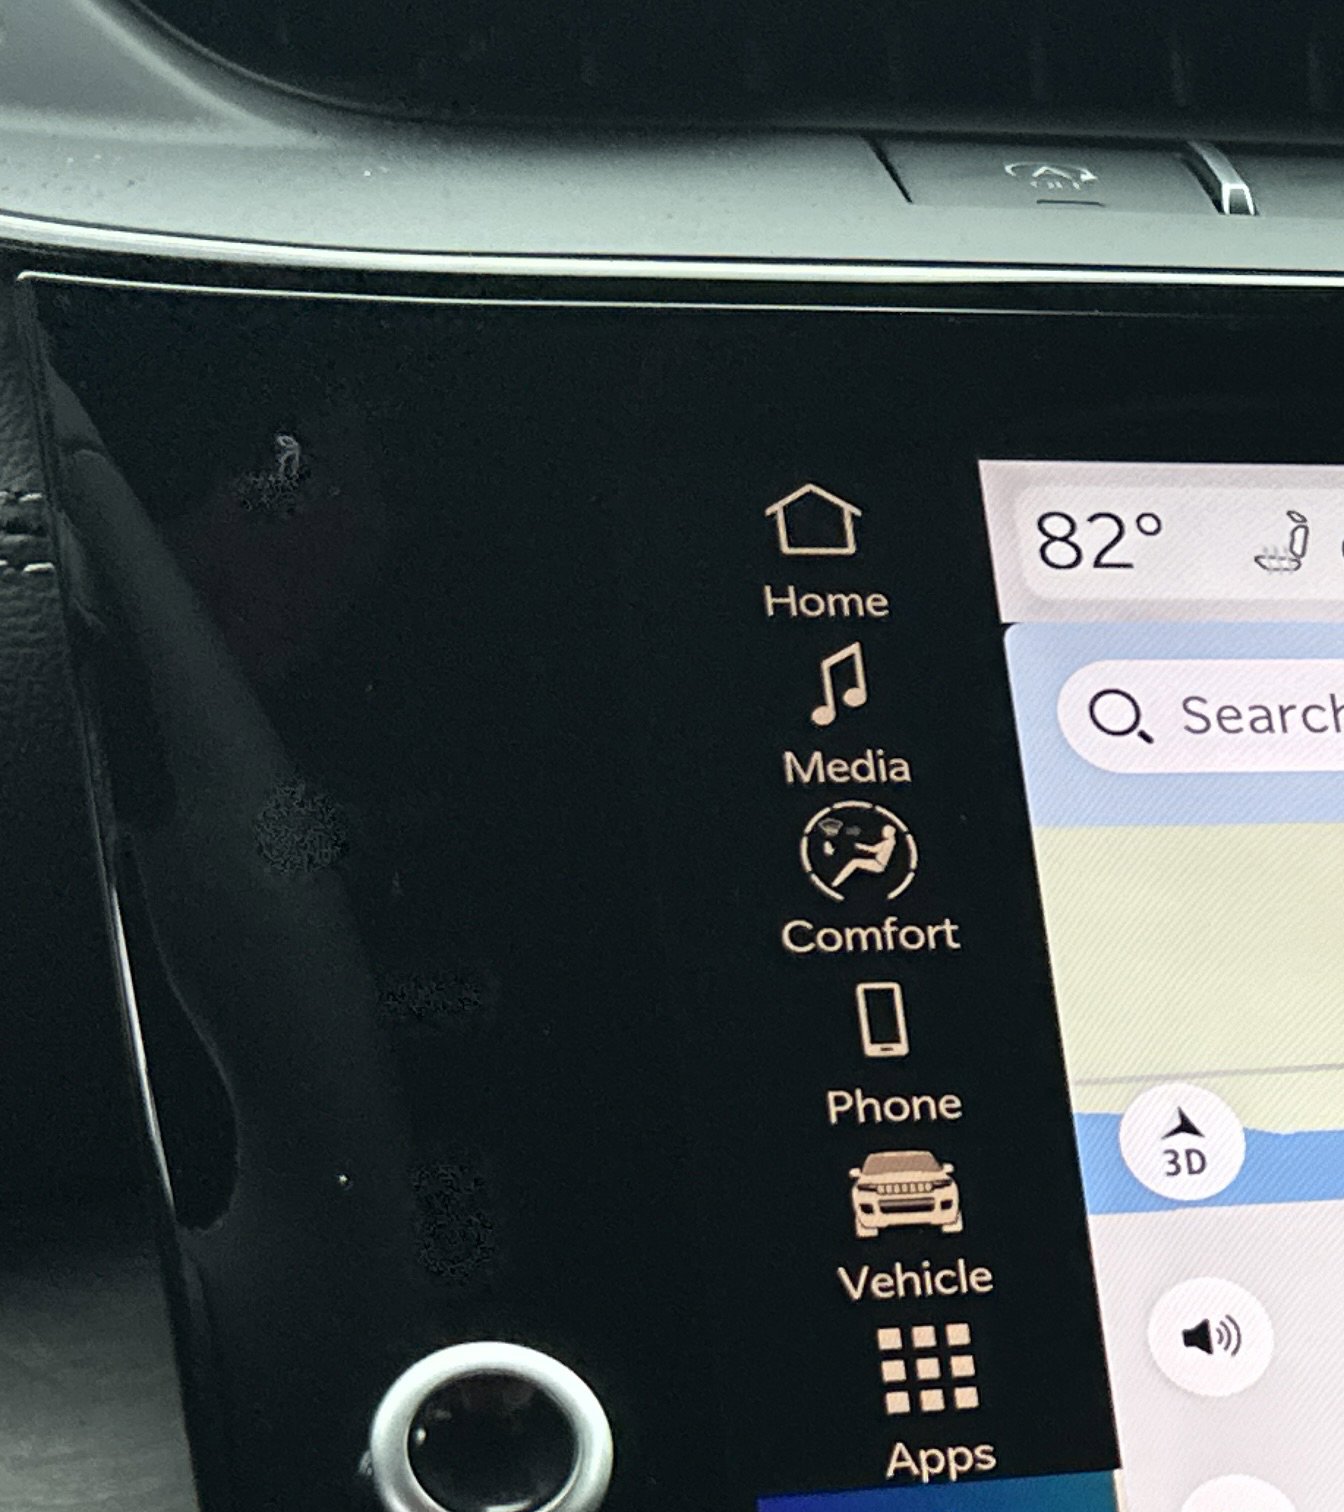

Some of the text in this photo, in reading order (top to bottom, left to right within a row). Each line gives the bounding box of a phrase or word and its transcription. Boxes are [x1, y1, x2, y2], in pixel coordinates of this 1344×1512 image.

[1036, 510, 1163, 571] 82°
[763, 584, 890, 618] Home
[782, 748, 912, 784] Media
[781, 915, 962, 954] Comfort
[826, 1087, 963, 1125] Phone
[1162, 1147, 1208, 1178] 3D
[836, 1257, 995, 1301] Vehicle
[885, 1441, 998, 1485] Apps
